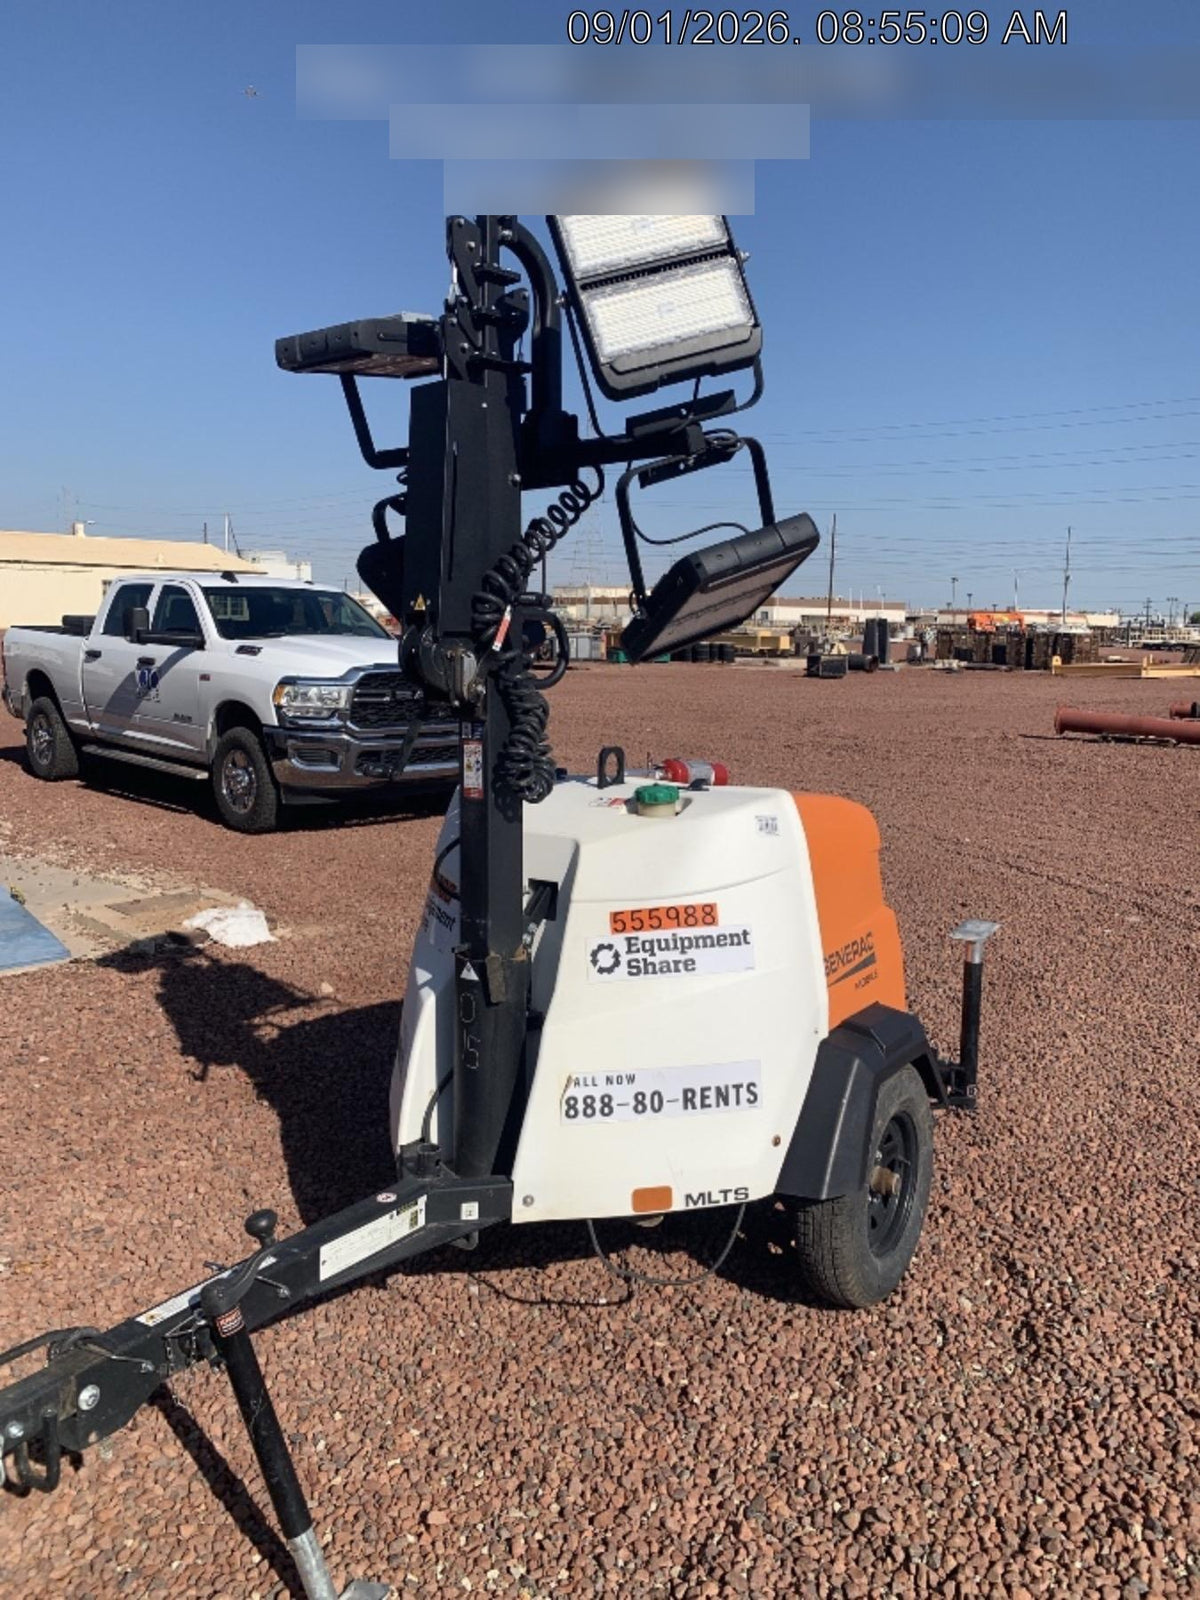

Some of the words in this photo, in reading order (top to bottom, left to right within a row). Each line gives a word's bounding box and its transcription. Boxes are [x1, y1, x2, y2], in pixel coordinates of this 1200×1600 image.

[612, 904, 716, 932] 555988
[624, 929, 751, 956] Equipment
[627, 956, 697, 977] Share
[573, 1075, 598, 1088] ALL
[605, 1073, 636, 1086] NOW
[564, 1081, 759, 1120] 888-80-RENTS
[684, 1187, 749, 1207] MLTS
